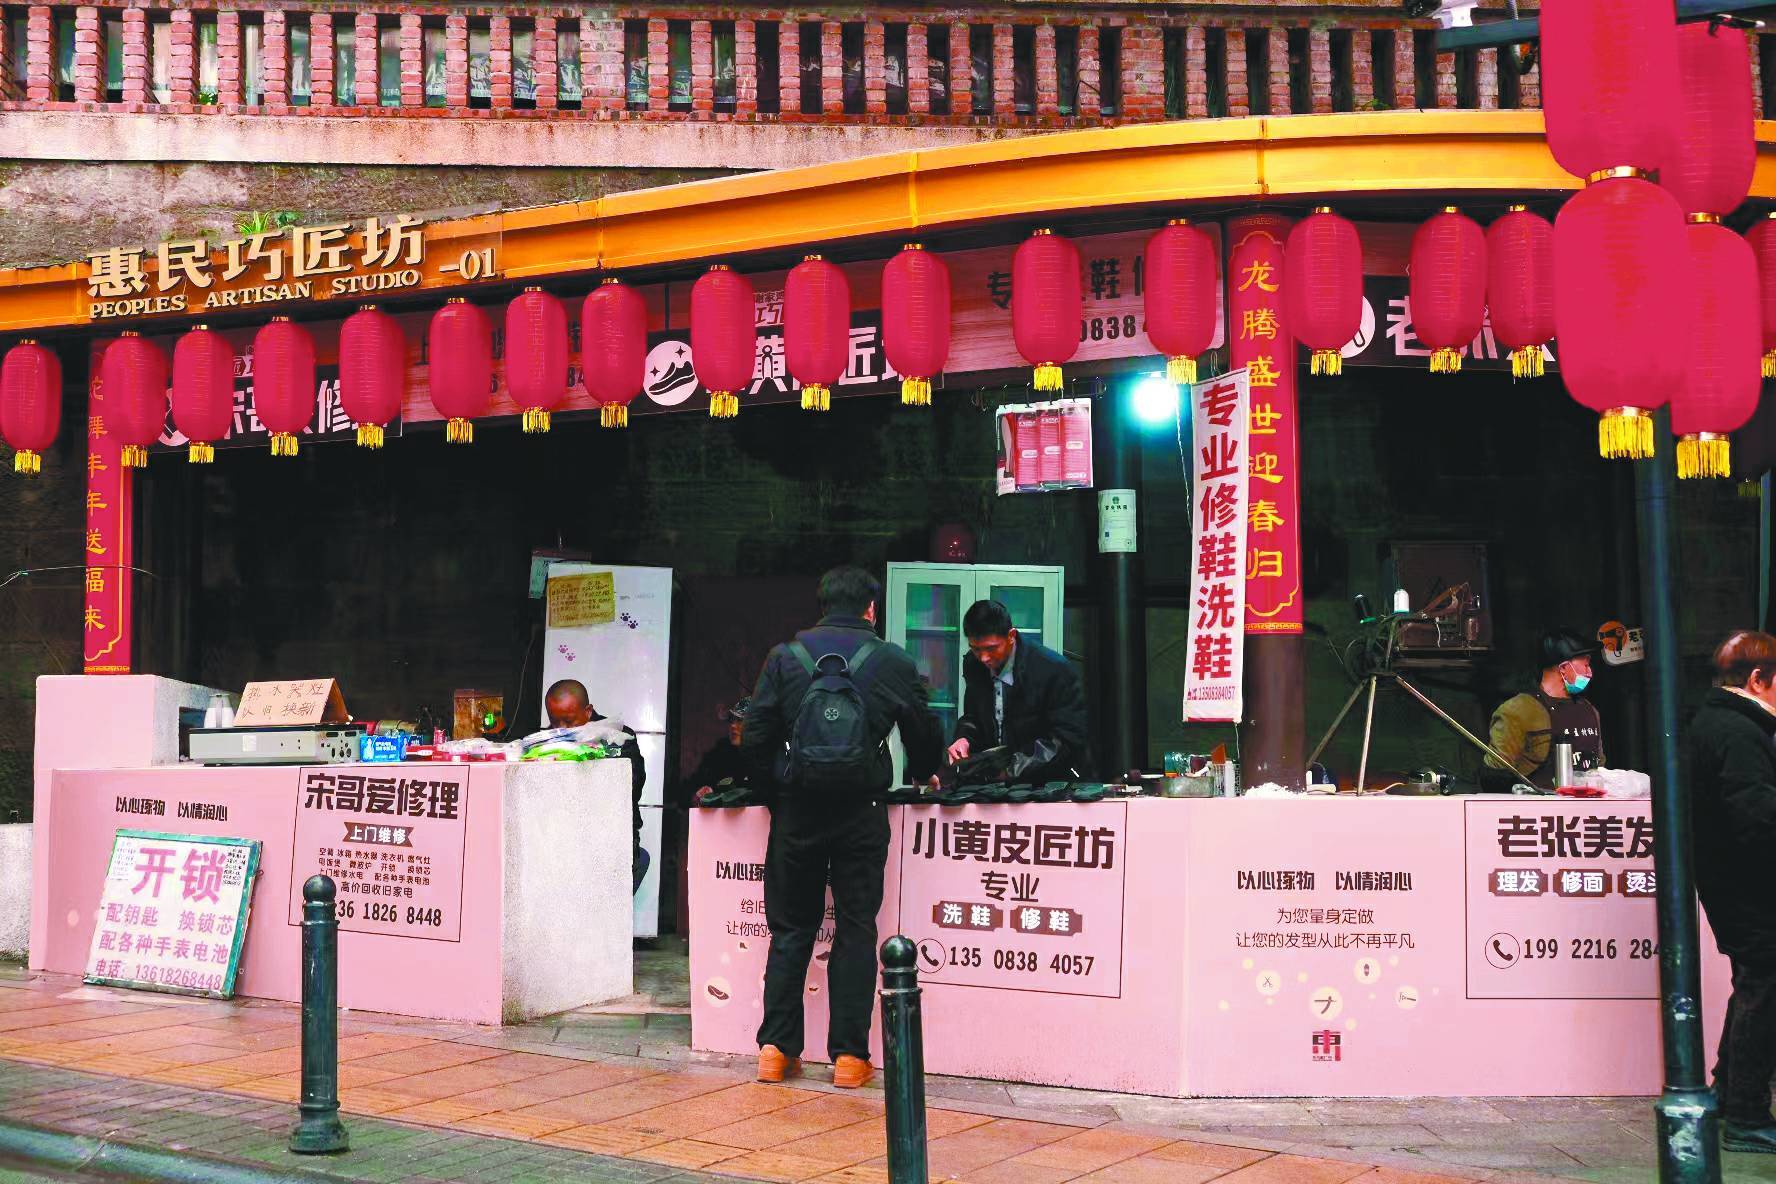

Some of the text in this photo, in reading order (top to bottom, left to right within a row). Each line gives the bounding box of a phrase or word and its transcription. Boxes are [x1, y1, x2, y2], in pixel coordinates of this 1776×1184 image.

[87, 213, 426, 298] 惠民巧匠坊
[89, 294, 187, 319] PEOPLES
[204, 281, 312, 309] ARTISAN
[331, 269, 422, 295] STUDIO
[1238, 260, 1285, 580] 龙腾盛世迎春归
[1192, 382, 1240, 680] 专业修鞋洗鞋
[115, 796, 228, 821] 以心琢物 以情润心
[304, 773, 460, 820] 宋哥爱修理
[349, 826, 407, 845] 上门维修
[911, 817, 1115, 870] 小黄皮匠坊
[1497, 815, 1656, 859] 老张美发
[131, 847, 227, 905] 开锁
[340, 881, 414, 898] 高价回收旧家电
[980, 870, 1040, 902] 专业
[1236, 870, 1413, 891] 以心琢物 以情润心
[1497, 871, 1540, 893] 理发
[1561, 871, 1604, 893] 修面
[105, 902, 236, 936] 配钥匙 换锁芯
[363, 902, 398, 923] 1826
[406, 906, 442, 926] 8448
[942, 903, 1070, 932] 洗鞋 修鞋
[1276, 908, 1374, 925] 为您量身定做
[98, 929, 230, 965] 配各种手表电池
[1235, 932, 1415, 949] 让您的发型从此不再平凡
[1524, 939, 1559, 959] 199
[1571, 939, 1617, 959] 2216
[949, 946, 1095, 976] 135 0838 4057
[135, 963, 222, 991] 13618268448
